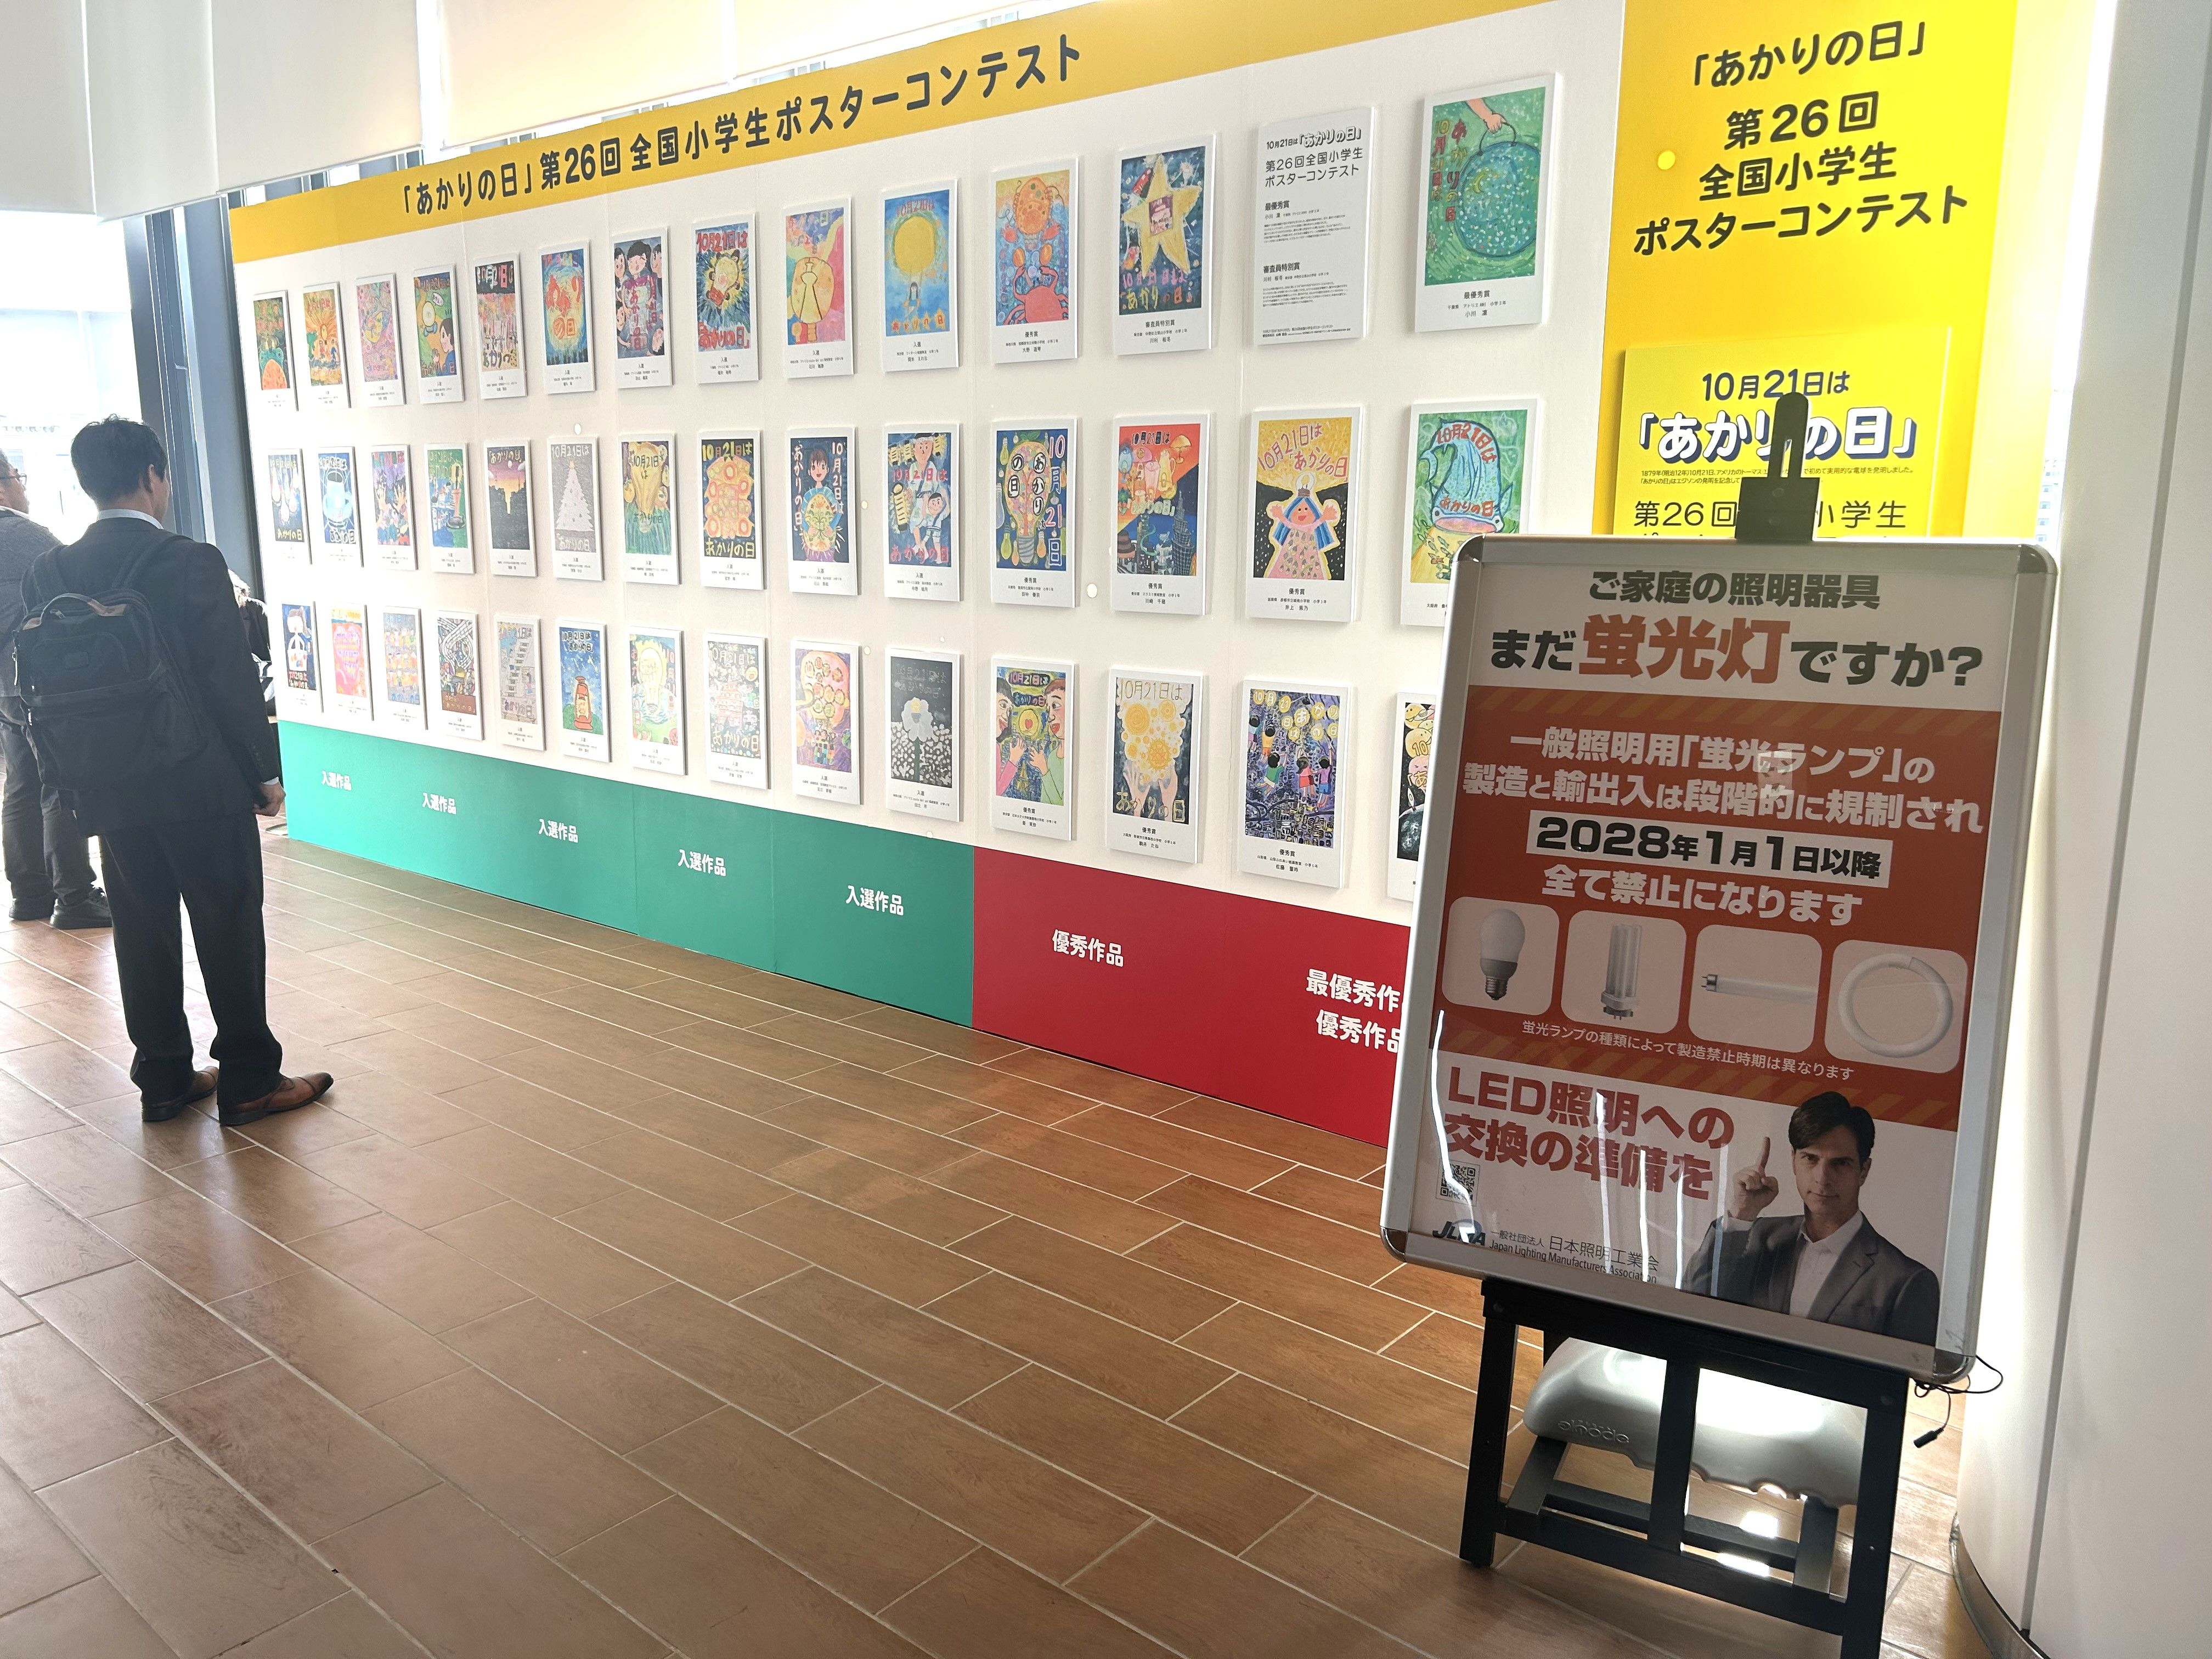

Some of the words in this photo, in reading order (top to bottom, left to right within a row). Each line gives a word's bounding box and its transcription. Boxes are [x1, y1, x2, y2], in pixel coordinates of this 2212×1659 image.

[1694, 20, 1925, 87] 「あかりの日」
[1724, 91, 1879, 150] 第26回
[1265, 165, 1359, 188] ポスターコンテスト
[1266, 147, 1363, 173] 第26回全国小学生
[1700, 141, 1897, 201] 全国小学生
[1634, 185, 1968, 256] ポスターコンテスト
[1702, 369, 1850, 401] 10月21日は
[552, 444, 590, 459] 10月21日は
[1589, 571, 1881, 610] ご家庭の照明器具
[1120, 680, 1182, 701] 10月21日は
[1510, 726, 1935, 783] 一般照明用「蛍光ランプ」の
[321, 770, 352, 791] 入選作品
[1463, 762, 1984, 833] 製造と輸出入は段階的に規制され
[422, 792, 456, 815] 入選作品
[538, 818, 578, 843] 入選作品
[1537, 817, 1882, 879] 2028年1月1日以降
[678, 849, 727, 877] 入選作品
[845, 885, 904, 916] 入選作品
[1541, 864, 1863, 926] 全て禁止になります
[1052, 929, 1124, 968] 優秀作品
[1306, 968, 1403, 1013] 最優秀作
[1522, 1020, 1854, 1081] 蛍光ランプの種類によって製造禁止時期は異なります
[1449, 1066, 1734, 1149] LED照明への
[1444, 1113, 1713, 1200] 交換の準備を
[1491, 1229, 1544, 1248] 一般社団法人
[1488, 1239, 1513, 1254] Japan
[1515, 1244, 1547, 1263] Lighting
[1549, 1251, 1606, 1274] Manufacturers
[1609, 1265, 1657, 1284] Associaton
